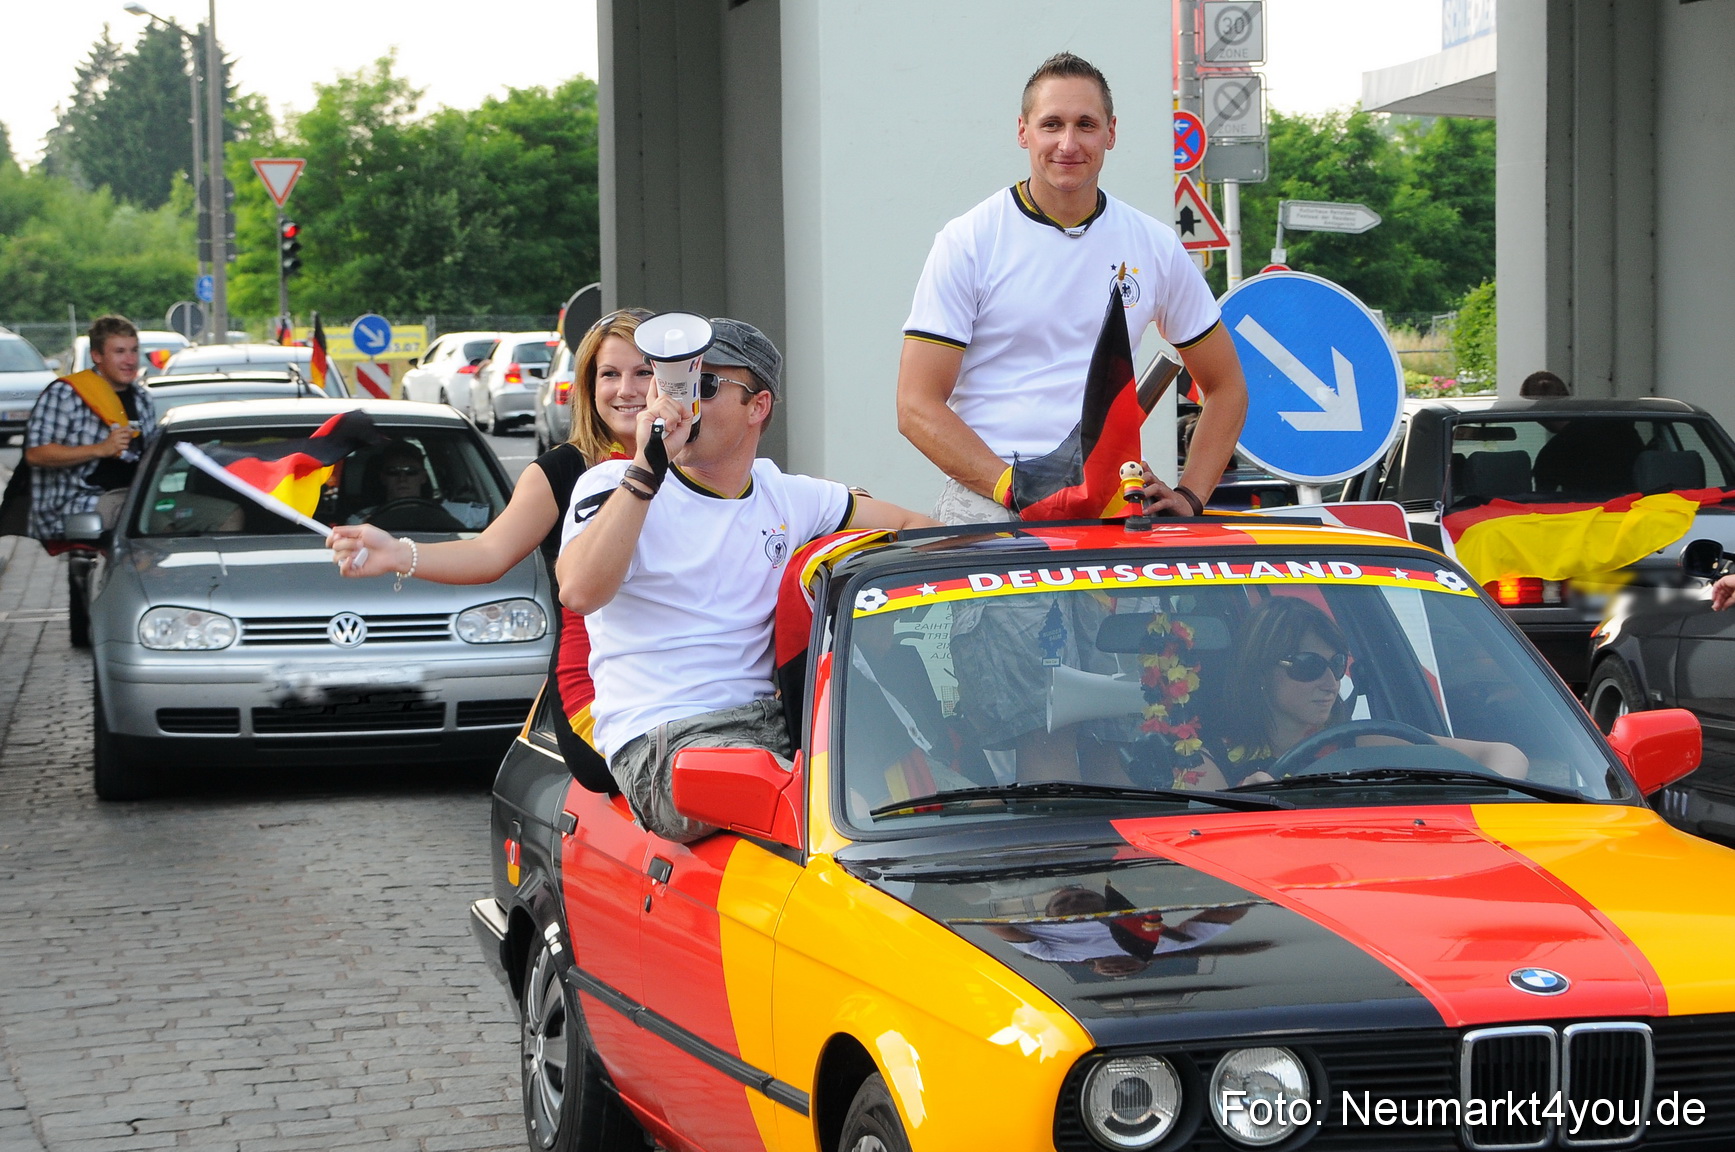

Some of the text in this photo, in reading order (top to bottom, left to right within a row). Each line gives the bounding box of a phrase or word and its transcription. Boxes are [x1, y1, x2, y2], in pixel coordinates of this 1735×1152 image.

[1222, 16, 1245, 35] 30
[1219, 48, 1249, 59] ZONE
[1218, 123, 1248, 134] ZONE
[967, 560, 1363, 592] DEUTSCHLAND
